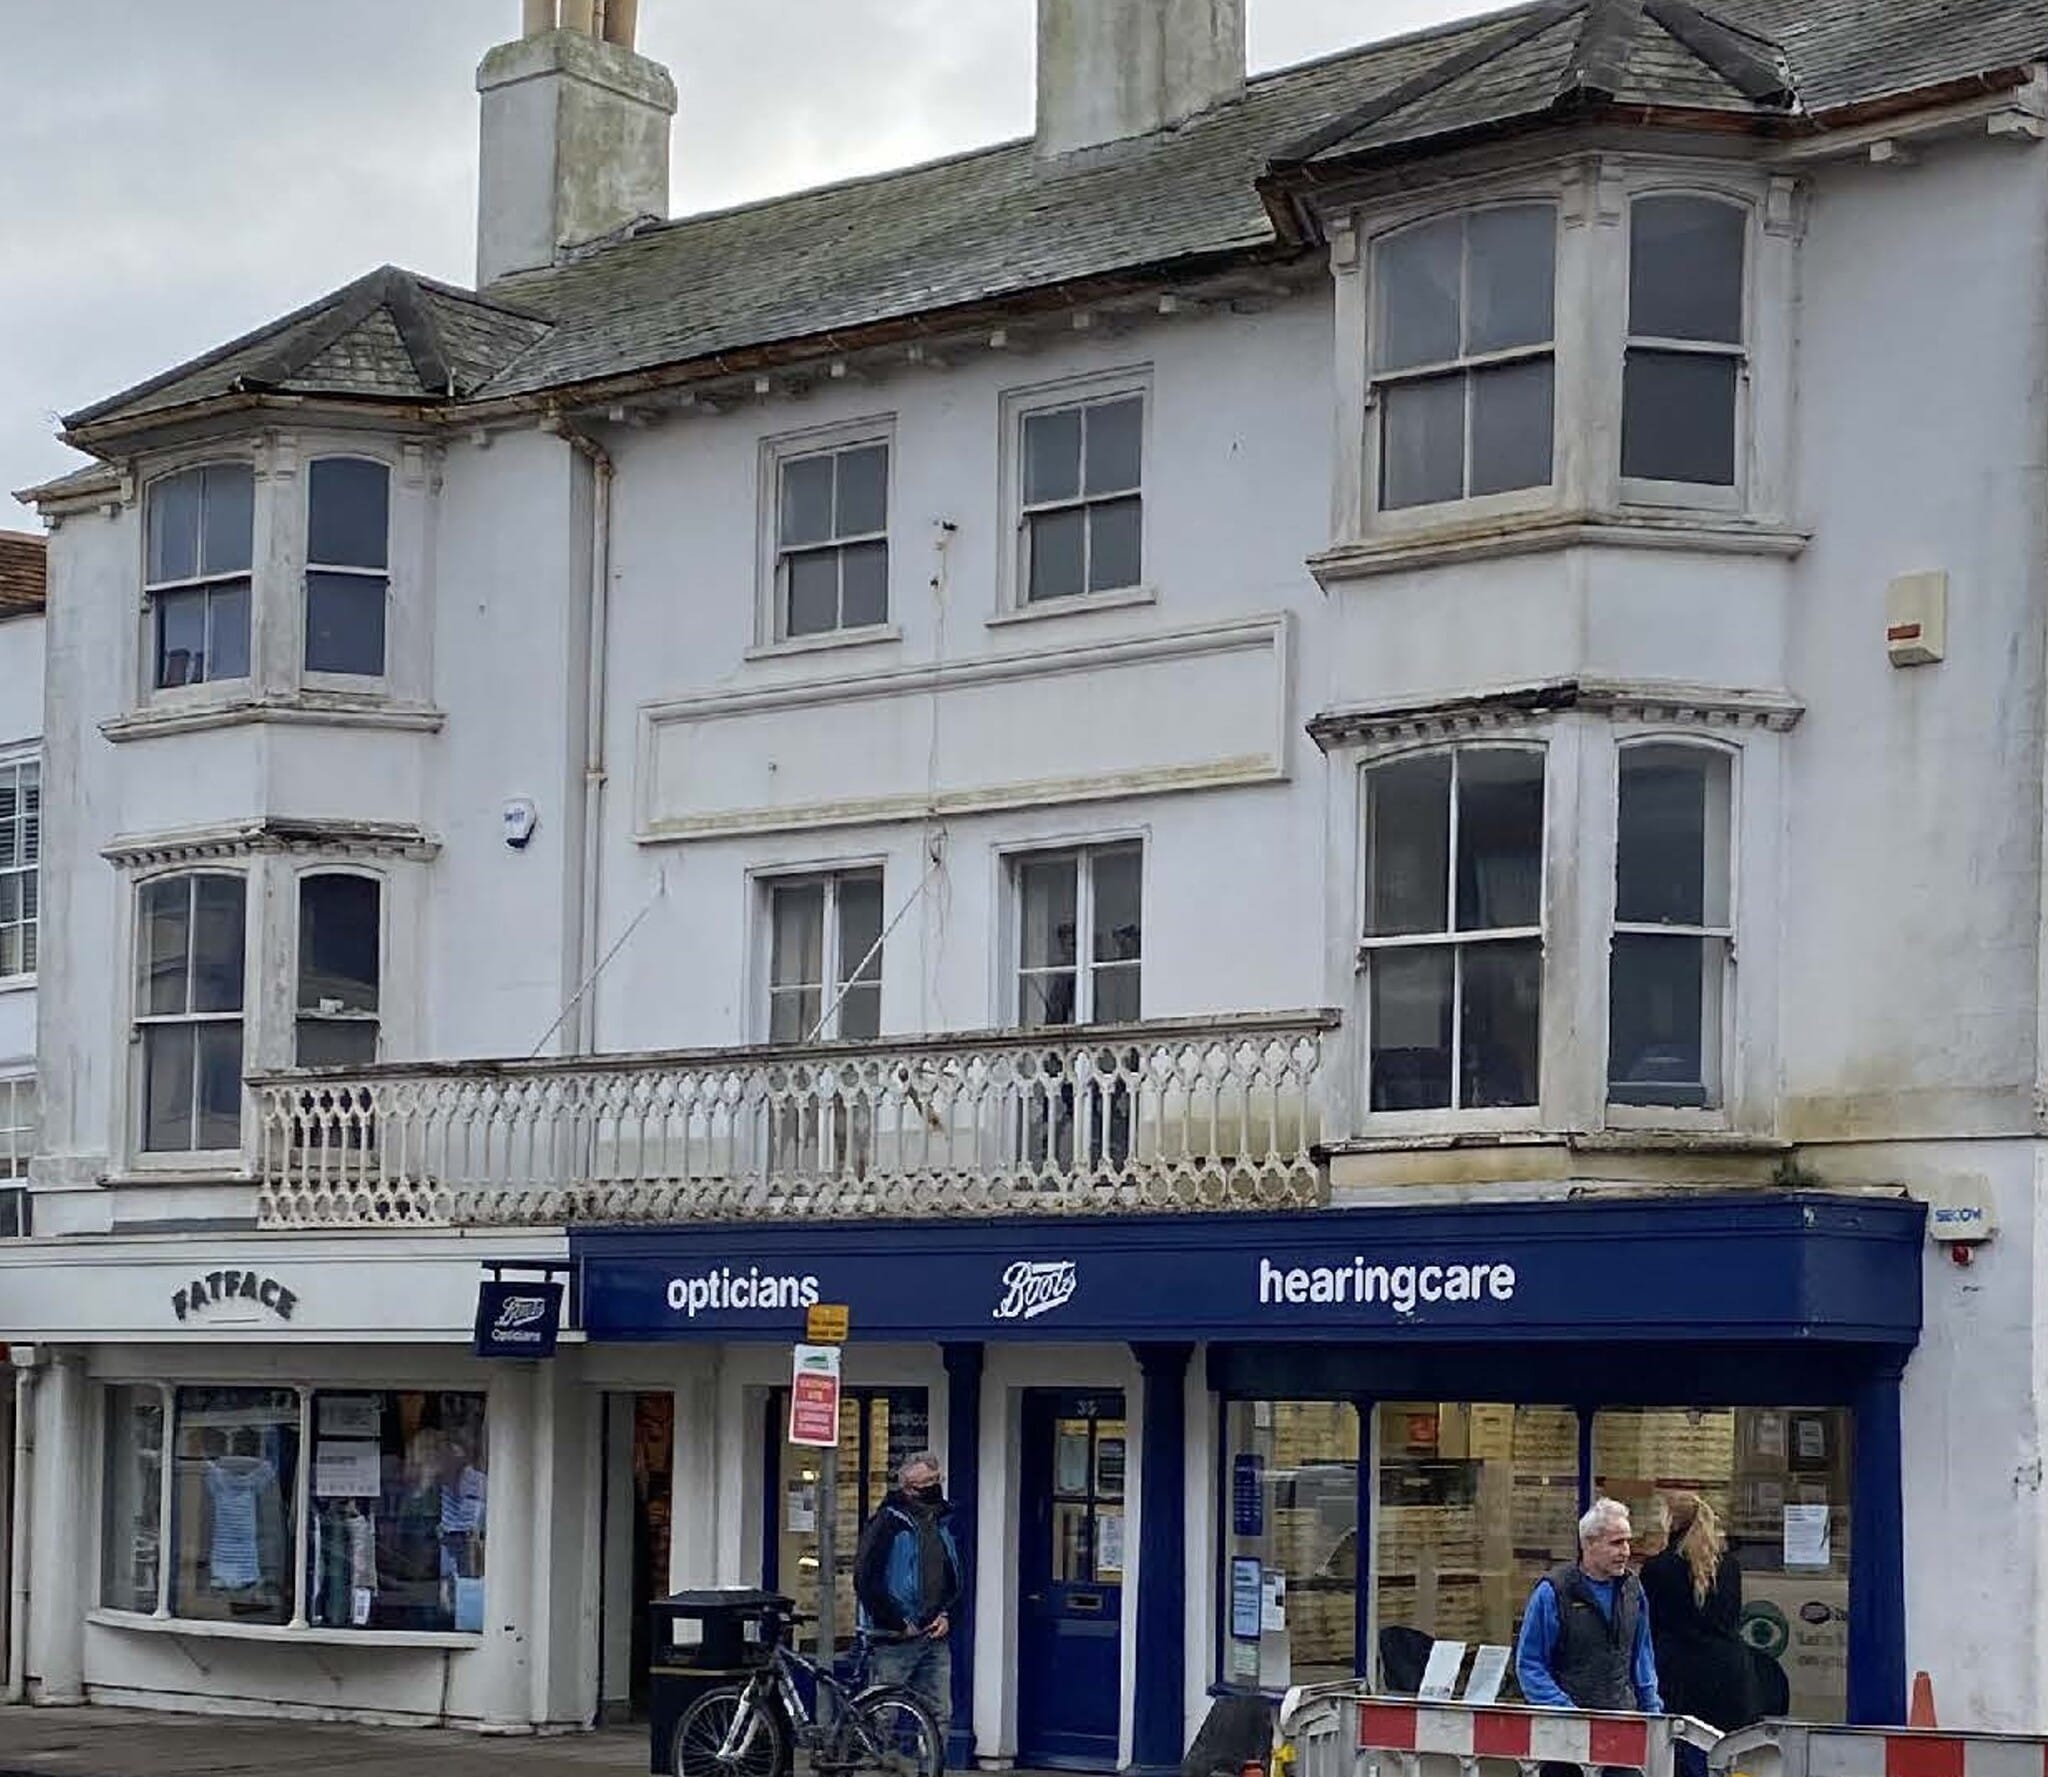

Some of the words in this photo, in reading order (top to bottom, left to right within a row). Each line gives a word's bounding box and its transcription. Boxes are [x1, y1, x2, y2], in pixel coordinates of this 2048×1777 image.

[171, 1270, 297, 1320] FATFACE
[667, 1266, 819, 1317] opticians
[993, 1261, 1076, 1319] Boots
[1259, 1256, 1516, 1312] hearingcare
